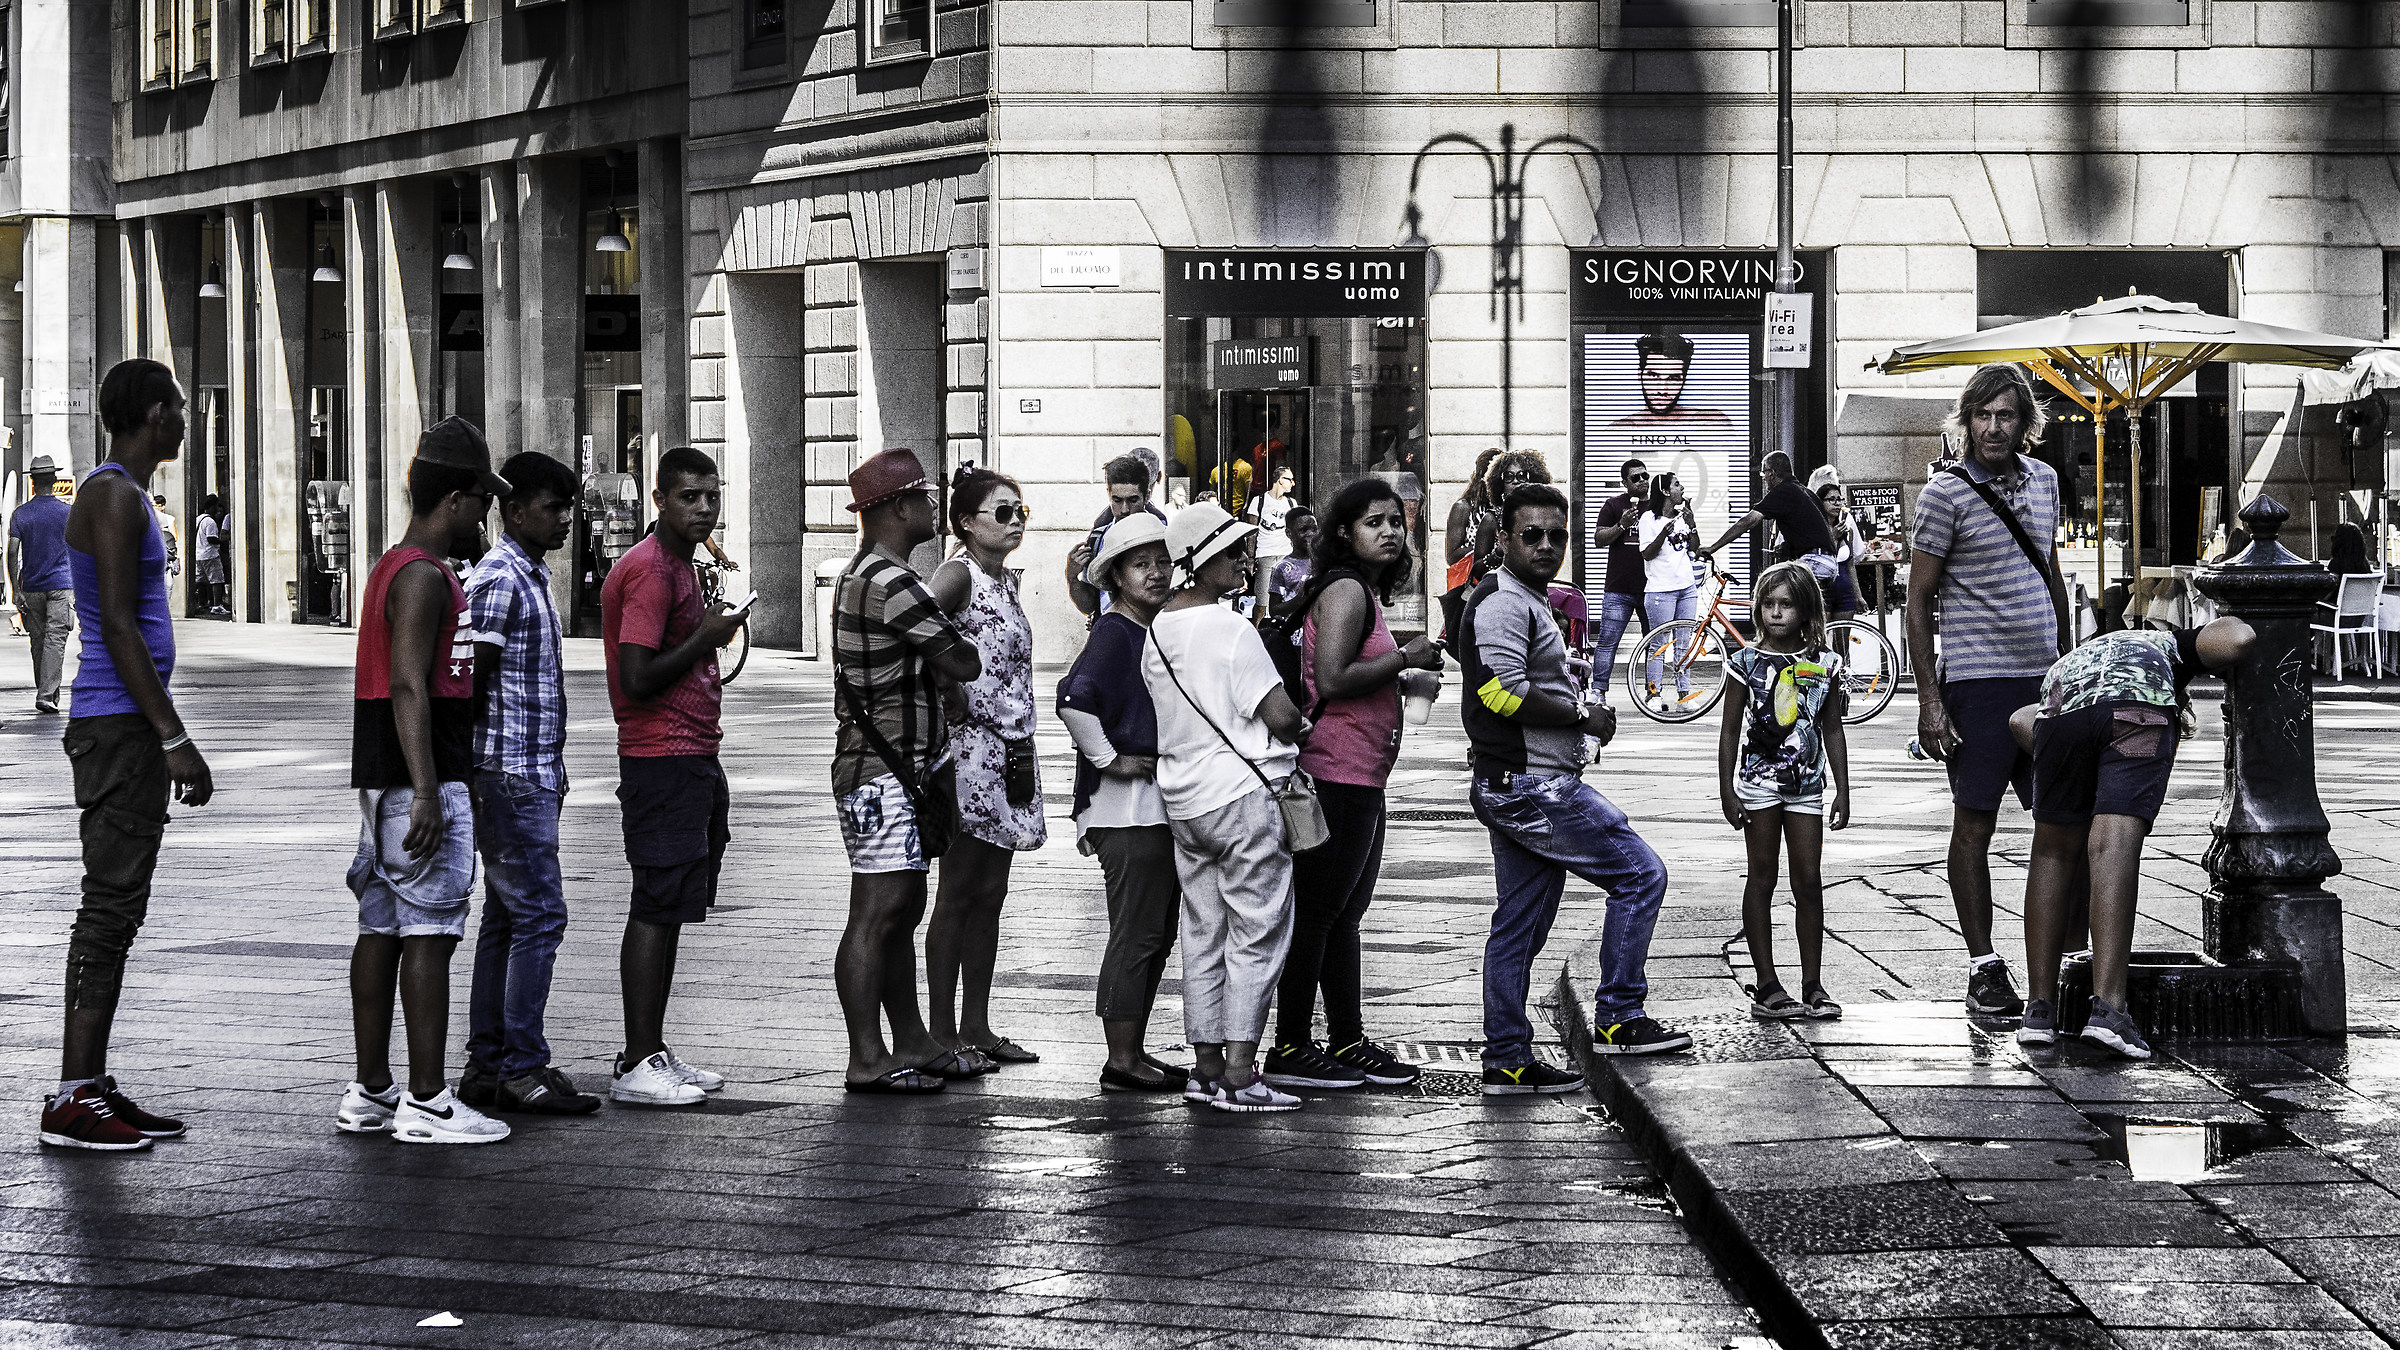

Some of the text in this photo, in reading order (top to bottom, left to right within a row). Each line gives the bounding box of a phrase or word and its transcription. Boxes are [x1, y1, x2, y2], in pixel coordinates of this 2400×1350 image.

[1071, 265, 1110, 274] DUOMO
[1184, 258, 1406, 281] intimissimi
[1344, 286, 1400, 300] uomo
[1628, 287, 1761, 300] 100% VINI ITALIANI
[1768, 324, 1795, 335] rea
[1221, 345, 1300, 366] intimissimi
[1278, 368, 1300, 382] uomo
[1631, 435, 1690, 445] FINO AL
[1878, 488, 1899, 496] FOOD
[1855, 496, 1897, 505] TASTING
